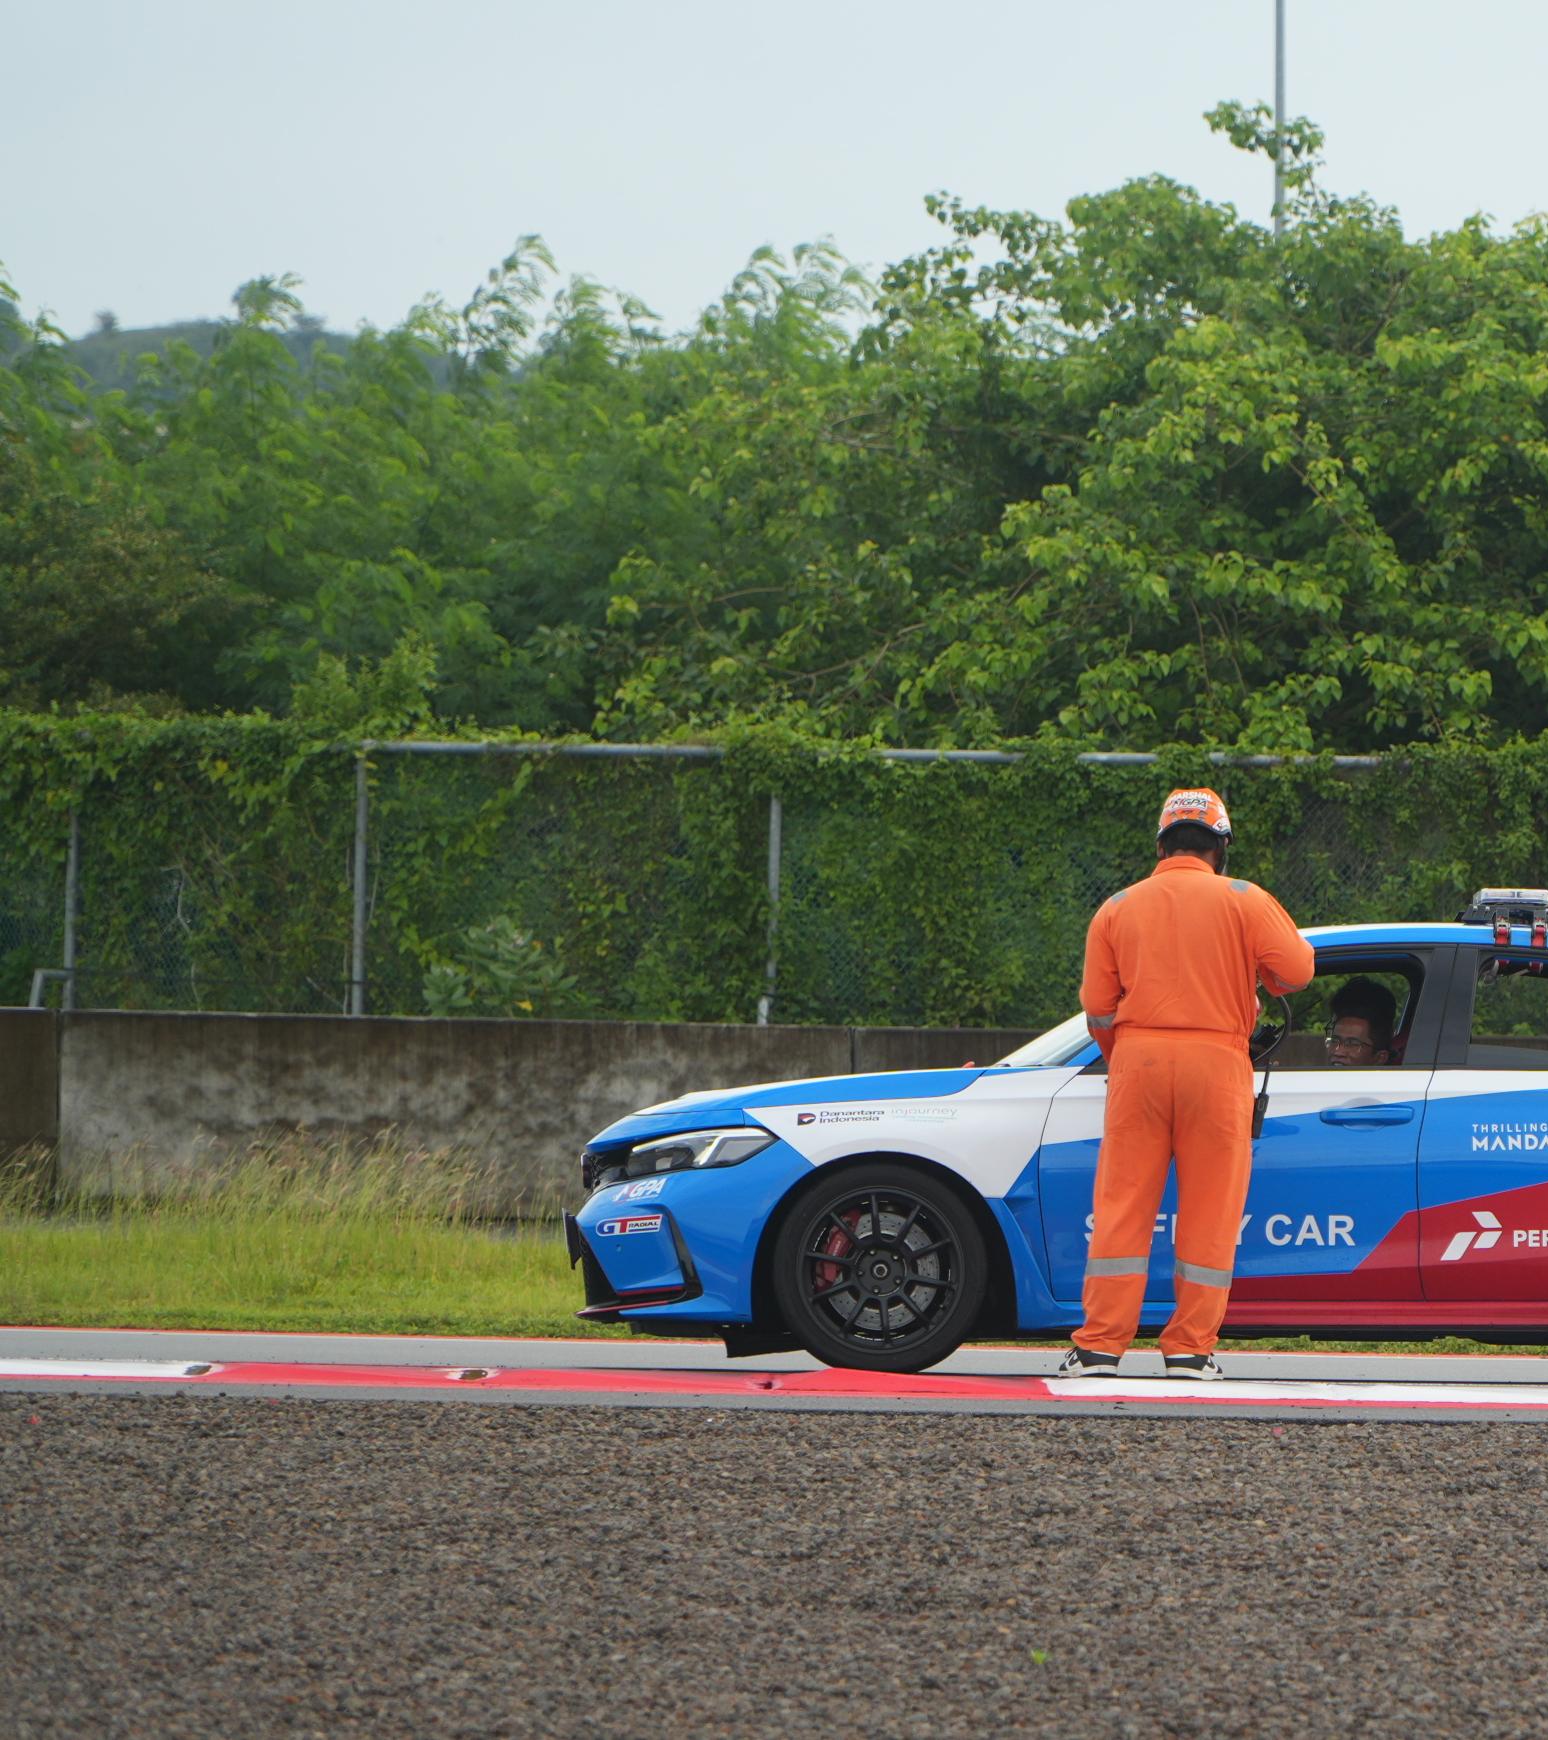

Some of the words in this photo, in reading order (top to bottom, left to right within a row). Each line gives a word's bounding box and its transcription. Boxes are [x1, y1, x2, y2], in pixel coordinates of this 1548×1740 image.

[819, 1115, 880, 1124] Indonesia
[1472, 1123, 1548, 1133] THRILLING
[597, 1218, 628, 1235] GT
[628, 1221, 659, 1229] RADIAL
[1265, 1214, 1357, 1247] CAR
